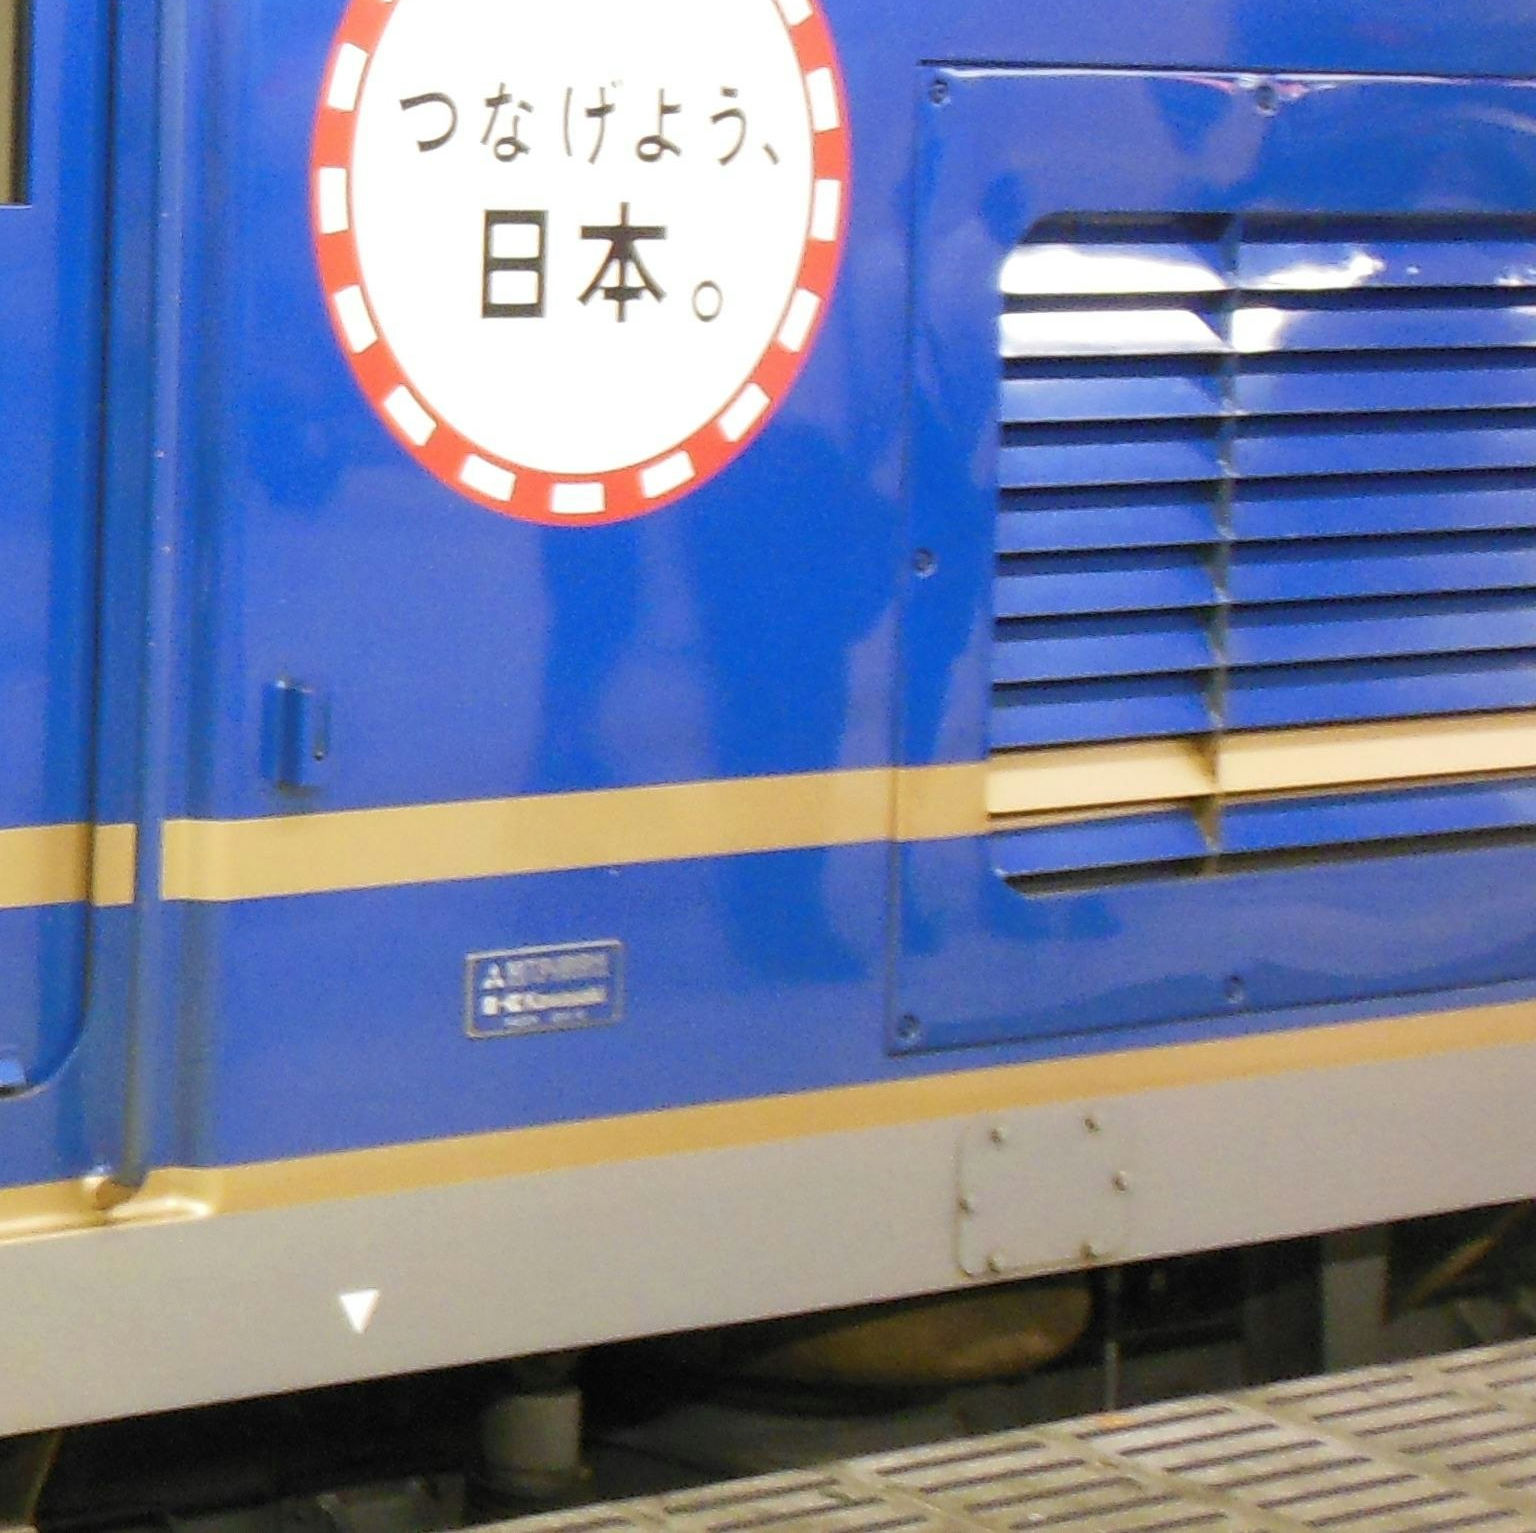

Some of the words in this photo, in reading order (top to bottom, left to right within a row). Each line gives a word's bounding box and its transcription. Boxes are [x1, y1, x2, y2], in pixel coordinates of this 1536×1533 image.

[398, 79, 781, 166] つなげよう、
[480, 201, 724, 323] 日本。
